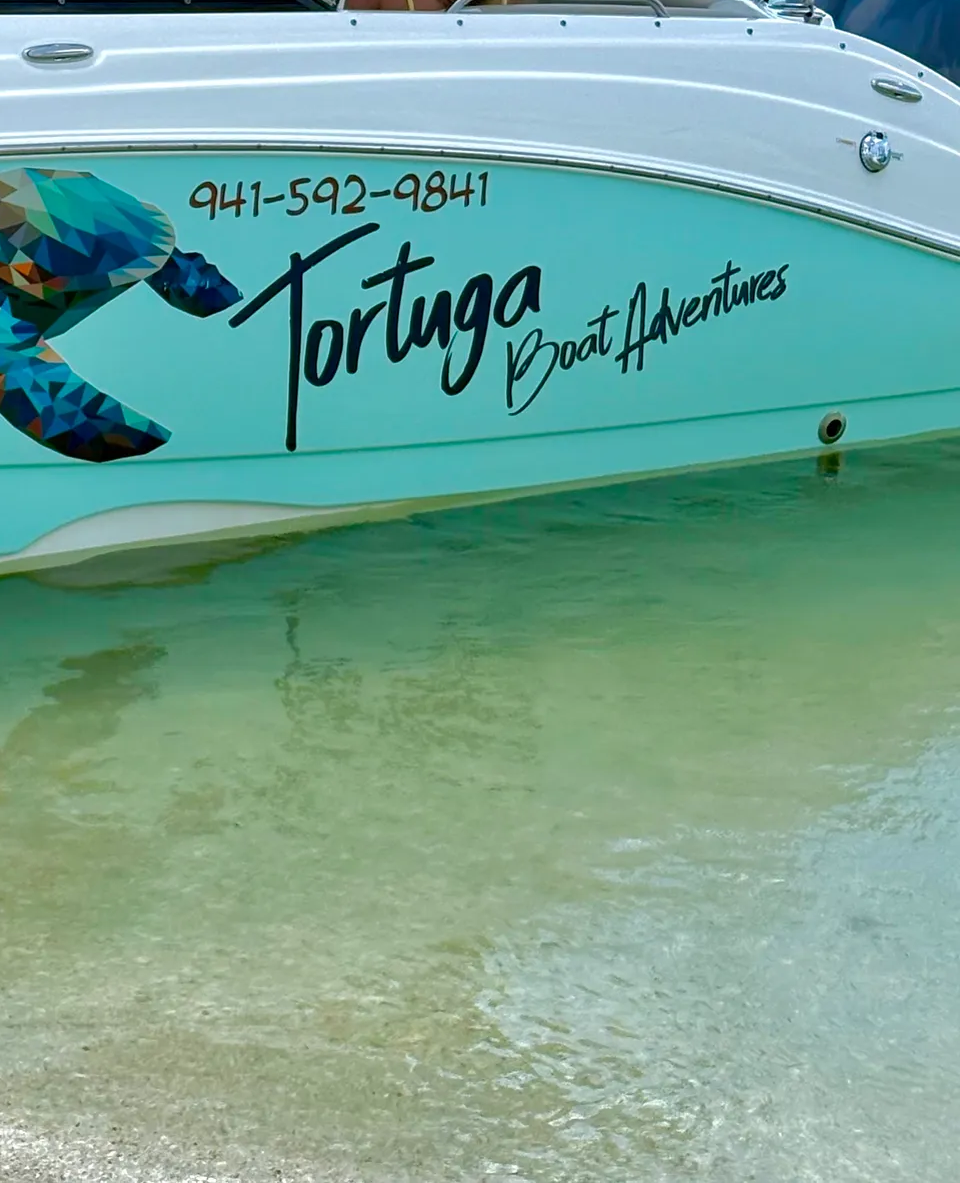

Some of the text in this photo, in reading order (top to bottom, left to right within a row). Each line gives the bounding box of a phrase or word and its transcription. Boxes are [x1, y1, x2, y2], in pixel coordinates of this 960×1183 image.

[189, 171, 488, 219] 941-592-9841
[228, 222, 541, 452] Tortuga
[506, 259, 790, 416] Boat Adventures
